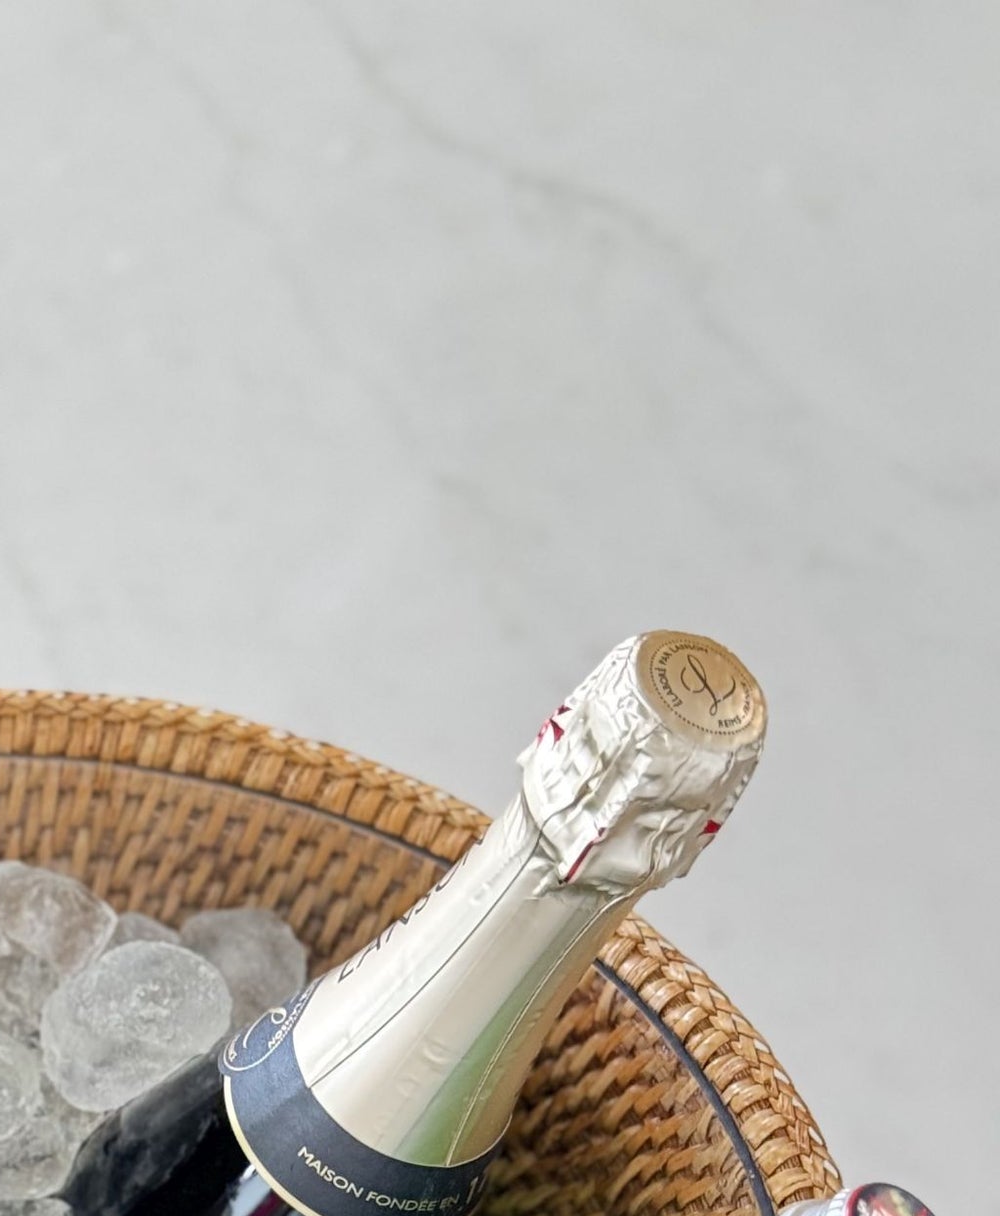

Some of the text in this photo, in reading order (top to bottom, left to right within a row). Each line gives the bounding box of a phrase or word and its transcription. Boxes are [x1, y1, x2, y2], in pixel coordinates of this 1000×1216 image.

[297, 1146, 364, 1198] MAISON
[365, 1191, 438, 1212] FONDÉE
[439, 1194, 460, 1210] EN
